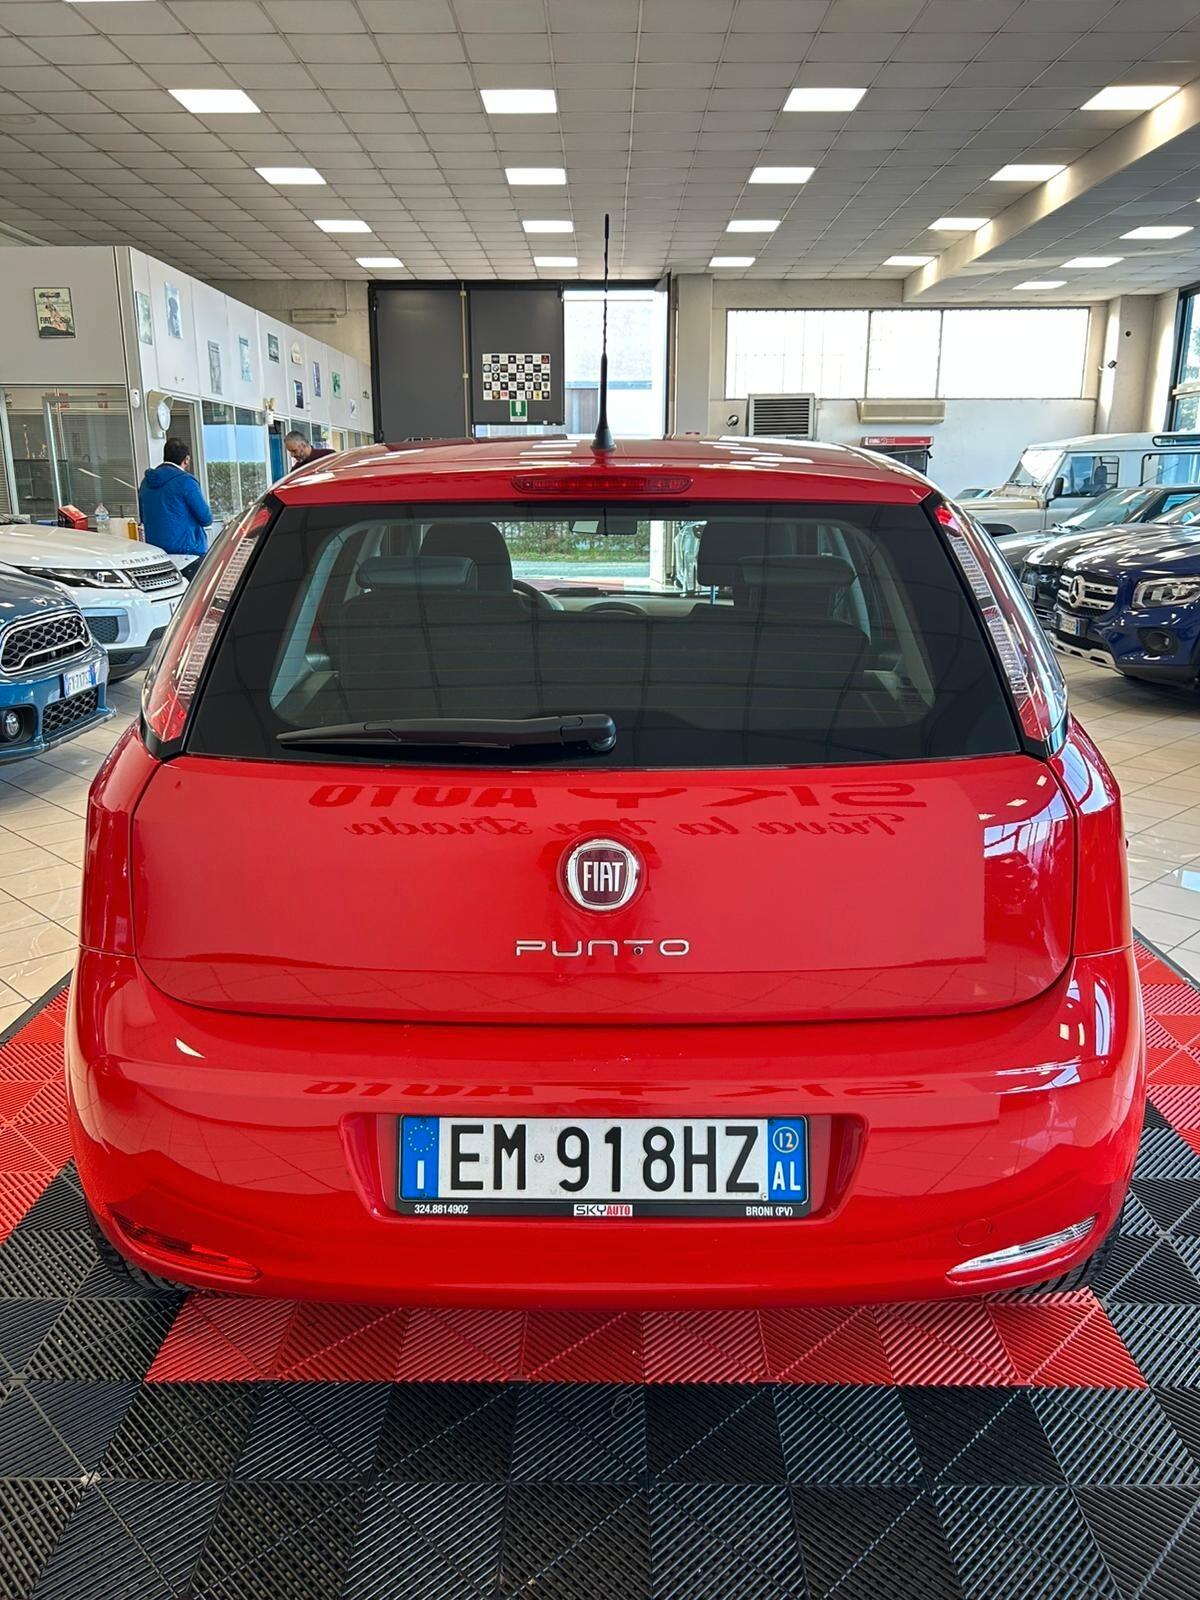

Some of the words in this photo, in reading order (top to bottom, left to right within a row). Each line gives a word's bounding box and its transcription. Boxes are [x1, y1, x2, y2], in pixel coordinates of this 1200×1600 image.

[583, 861, 624, 893] FIAT
[515, 938, 690, 957] PUNTO
[778, 1132, 794, 1149] 12
[450, 1124, 527, 1191] EM
[556, 1125, 760, 1194] 918HZ
[416, 1160, 425, 1190] I
[772, 1161, 802, 1191] AL
[414, 1204, 469, 1215] 324.8814902
[745, 1206, 773, 1217] BRONI
[775, 1206, 793, 1217] (PV)
